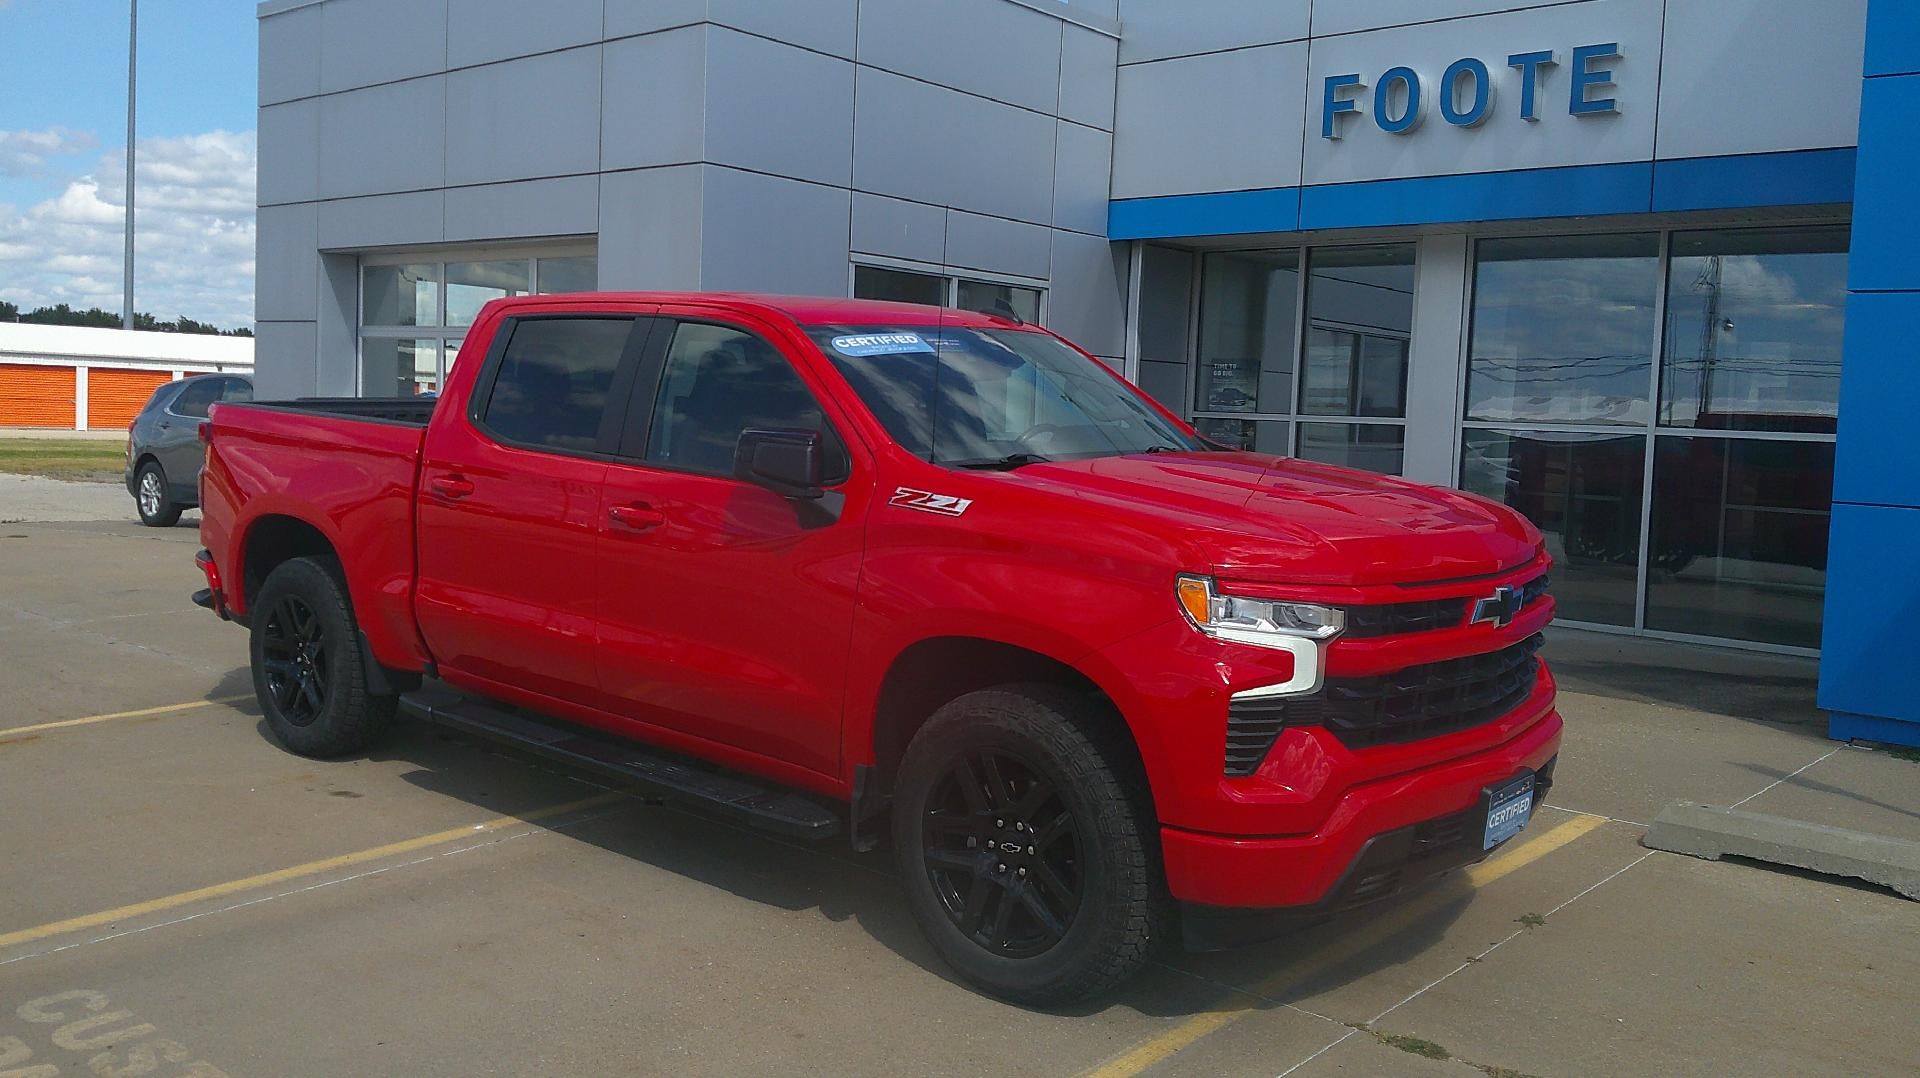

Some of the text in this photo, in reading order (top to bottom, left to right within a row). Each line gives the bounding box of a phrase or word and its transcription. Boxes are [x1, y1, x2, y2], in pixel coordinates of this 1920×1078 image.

[1321, 42, 1624, 140] FOOTE
[835, 334, 919, 349] CERTIFIED
[888, 486, 974, 517] Z71
[1489, 796, 1531, 829] CERTIFIED
